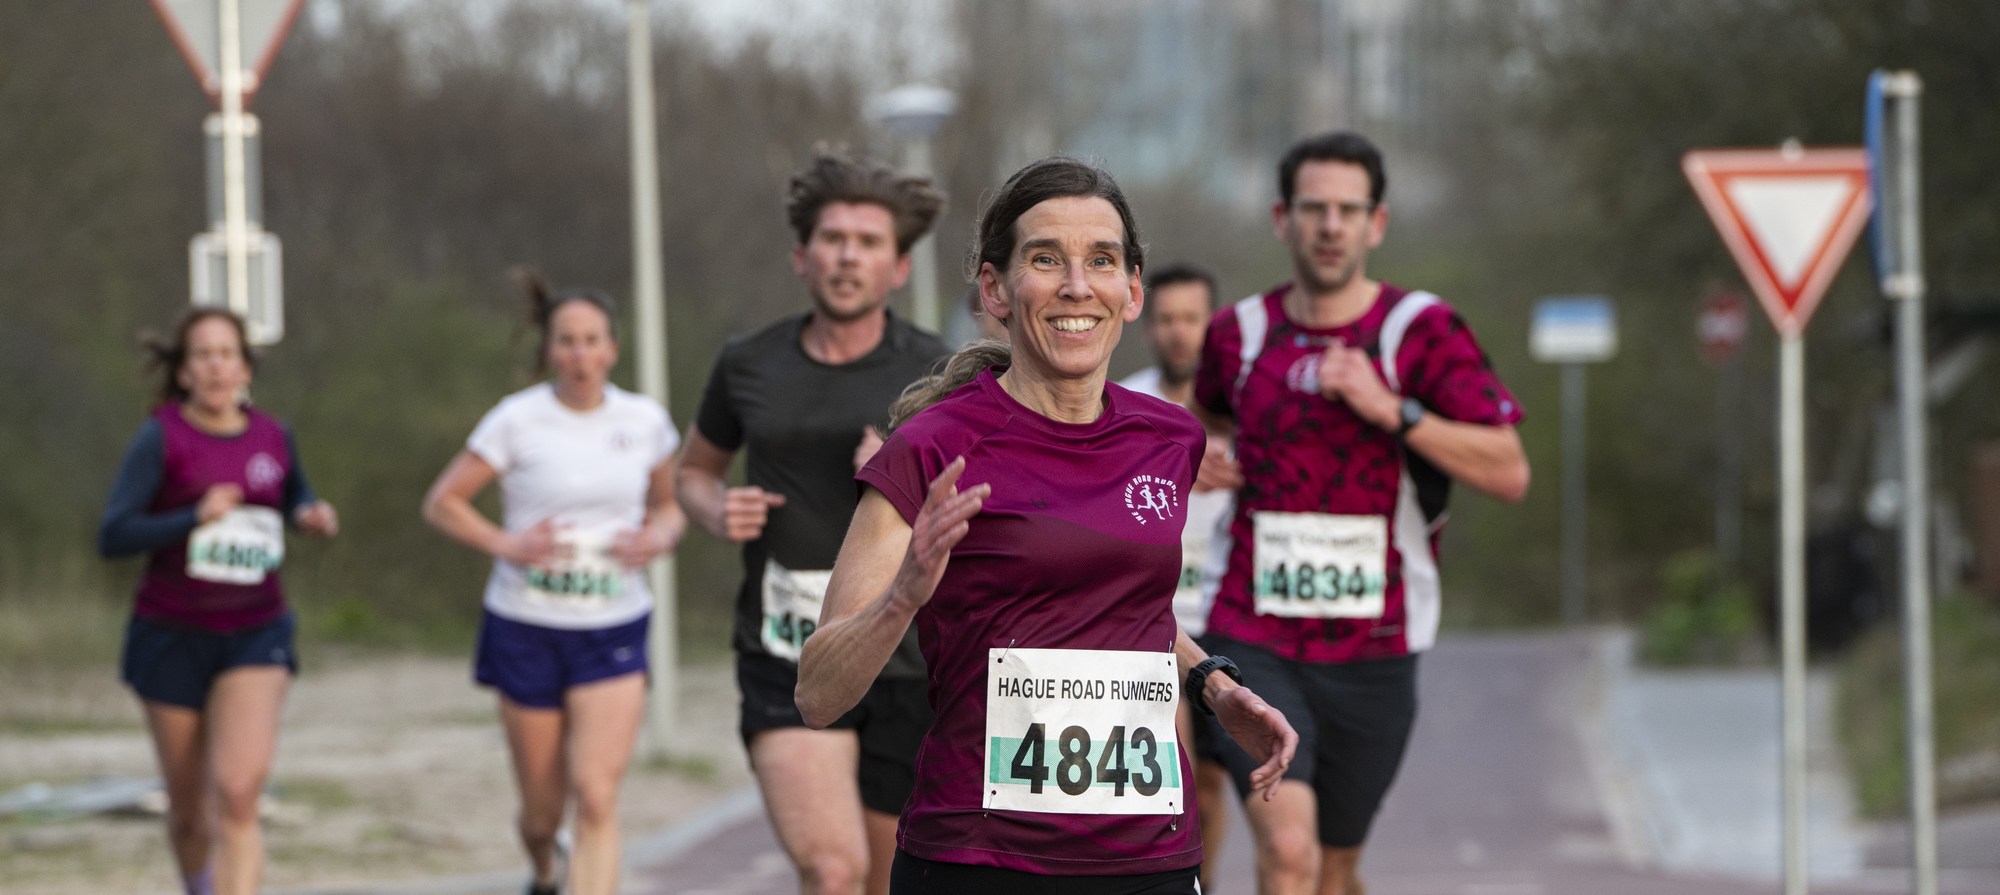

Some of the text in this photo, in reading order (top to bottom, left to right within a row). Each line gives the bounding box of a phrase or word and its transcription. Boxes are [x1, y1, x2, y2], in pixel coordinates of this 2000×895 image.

[1132, 475, 1152, 486] ROAD
[1124, 483, 1135, 509] HAGUE
[1131, 511, 1147, 525] THE
[1271, 562, 1366, 603] 4834
[997, 677, 1174, 703] HAGUE ROAD RUNNERS
[1010, 722, 1163, 797] 4843
